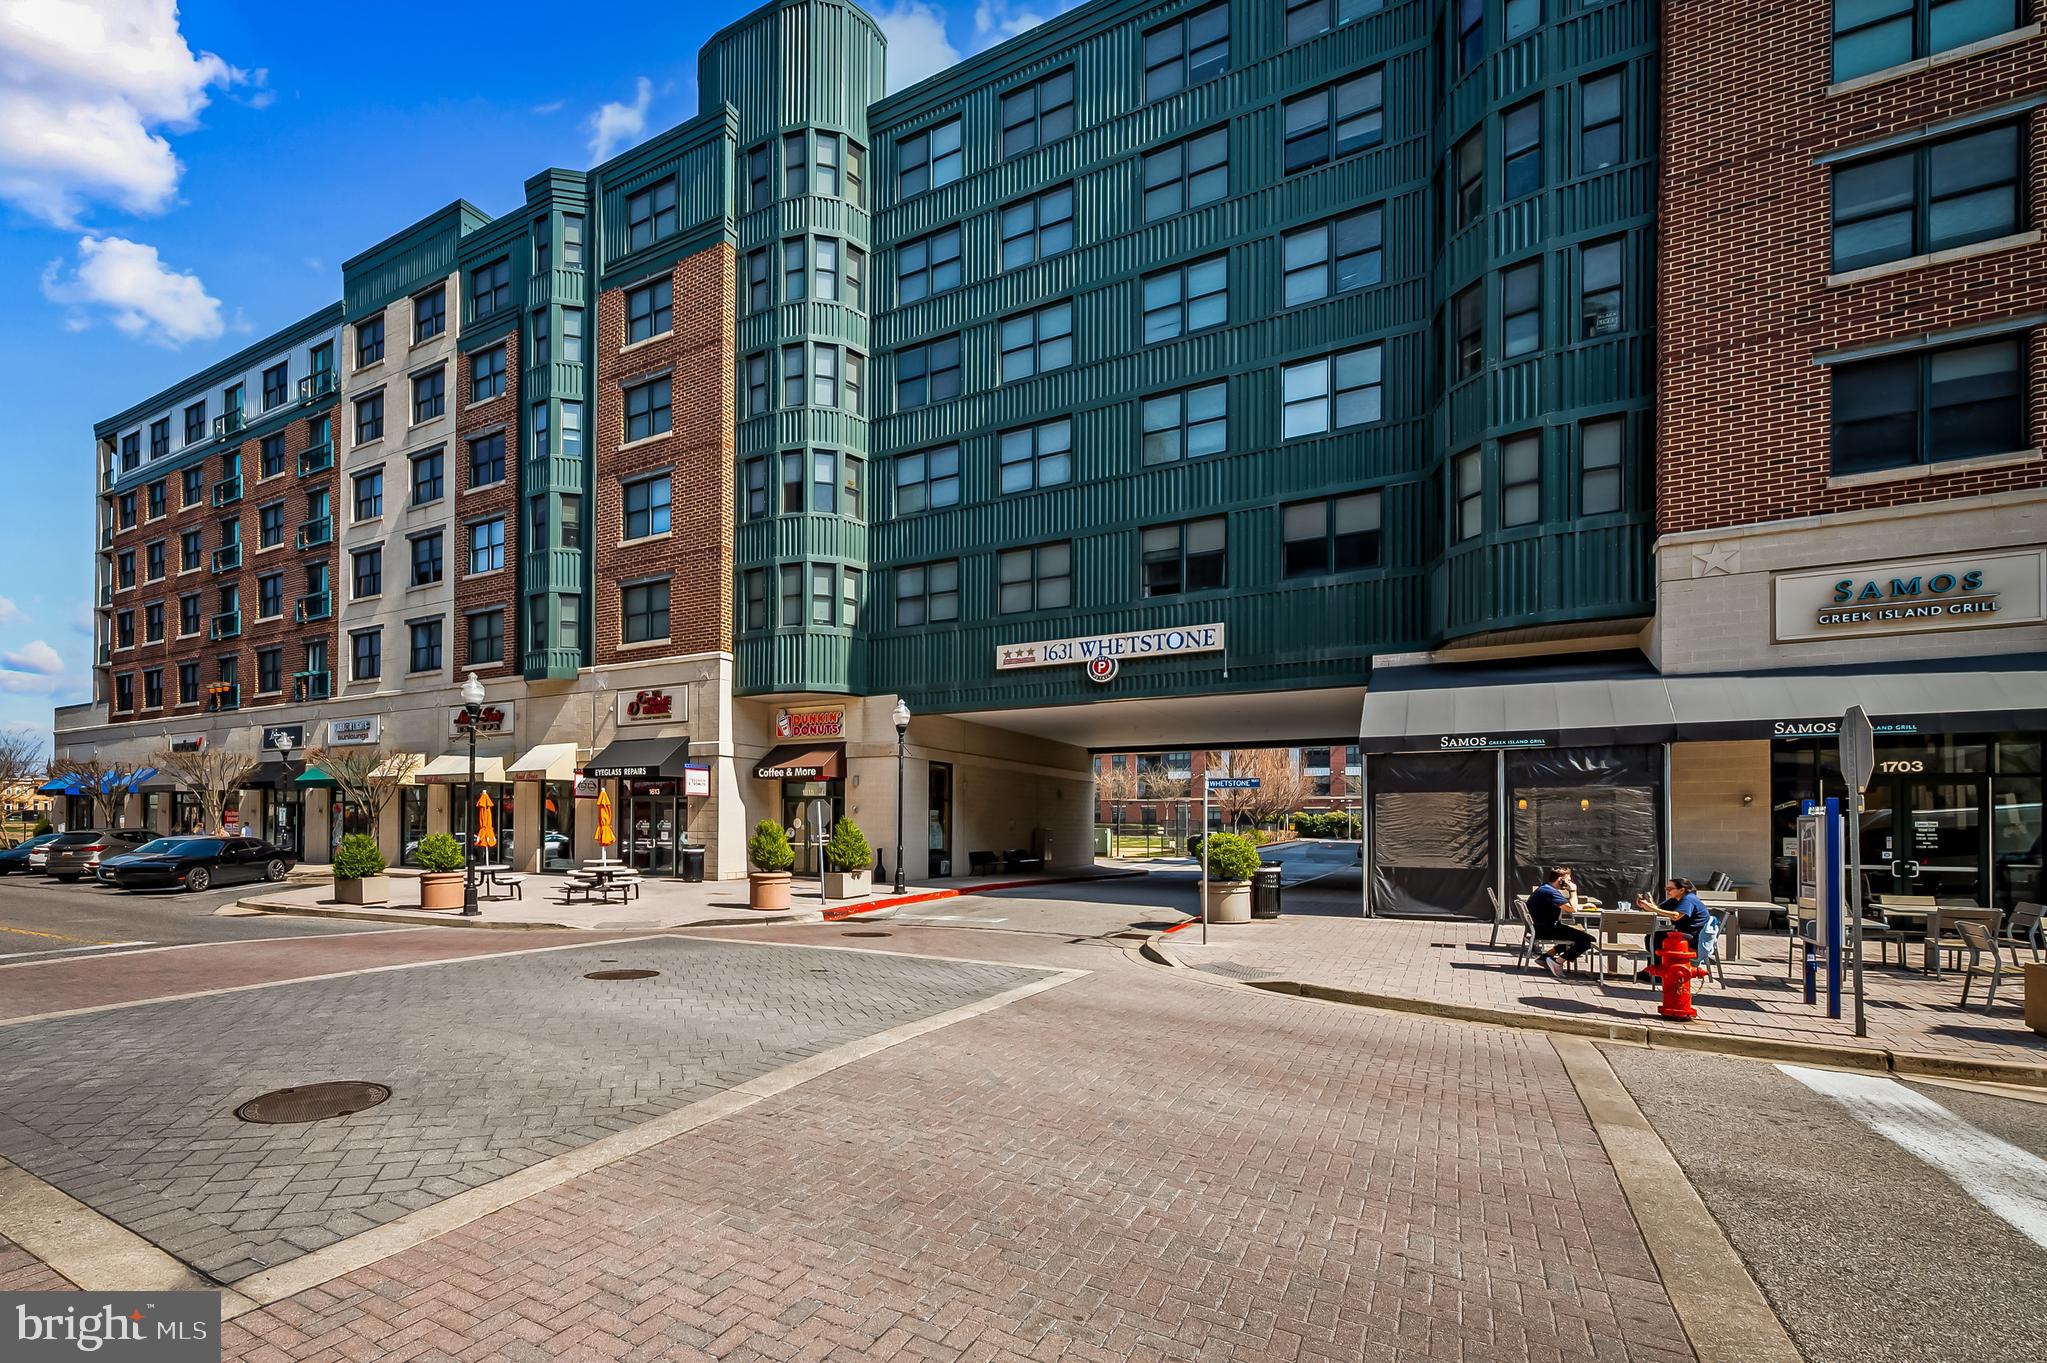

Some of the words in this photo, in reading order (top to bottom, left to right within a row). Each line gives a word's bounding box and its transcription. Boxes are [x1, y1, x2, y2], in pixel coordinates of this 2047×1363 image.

[1833, 570, 1983, 602] SAMOS
[1818, 611, 1872, 625] GREEK
[1877, 605, 1943, 620] ISLAND
[1948, 601, 2001, 615] GRILL
[1042, 643, 1073, 662] 1631
[1078, 628, 1216, 659] WHETSTONE
[793, 711, 843, 724] DUNKIN'
[793, 723, 840, 736] DONUTS
[1774, 721, 1836, 734] SAMOS
[1440, 736, 1487, 747] SAMOS
[594, 768, 622, 777] EYEGLASS
[623, 767, 647, 775] REPAIRS
[758, 768, 784, 777] Coffee
[786, 768, 793, 776] &
[794, 768, 816, 776] More
[1879, 760, 1924, 773] 1703
[1210, 779, 1250, 787] WHETSTONE
